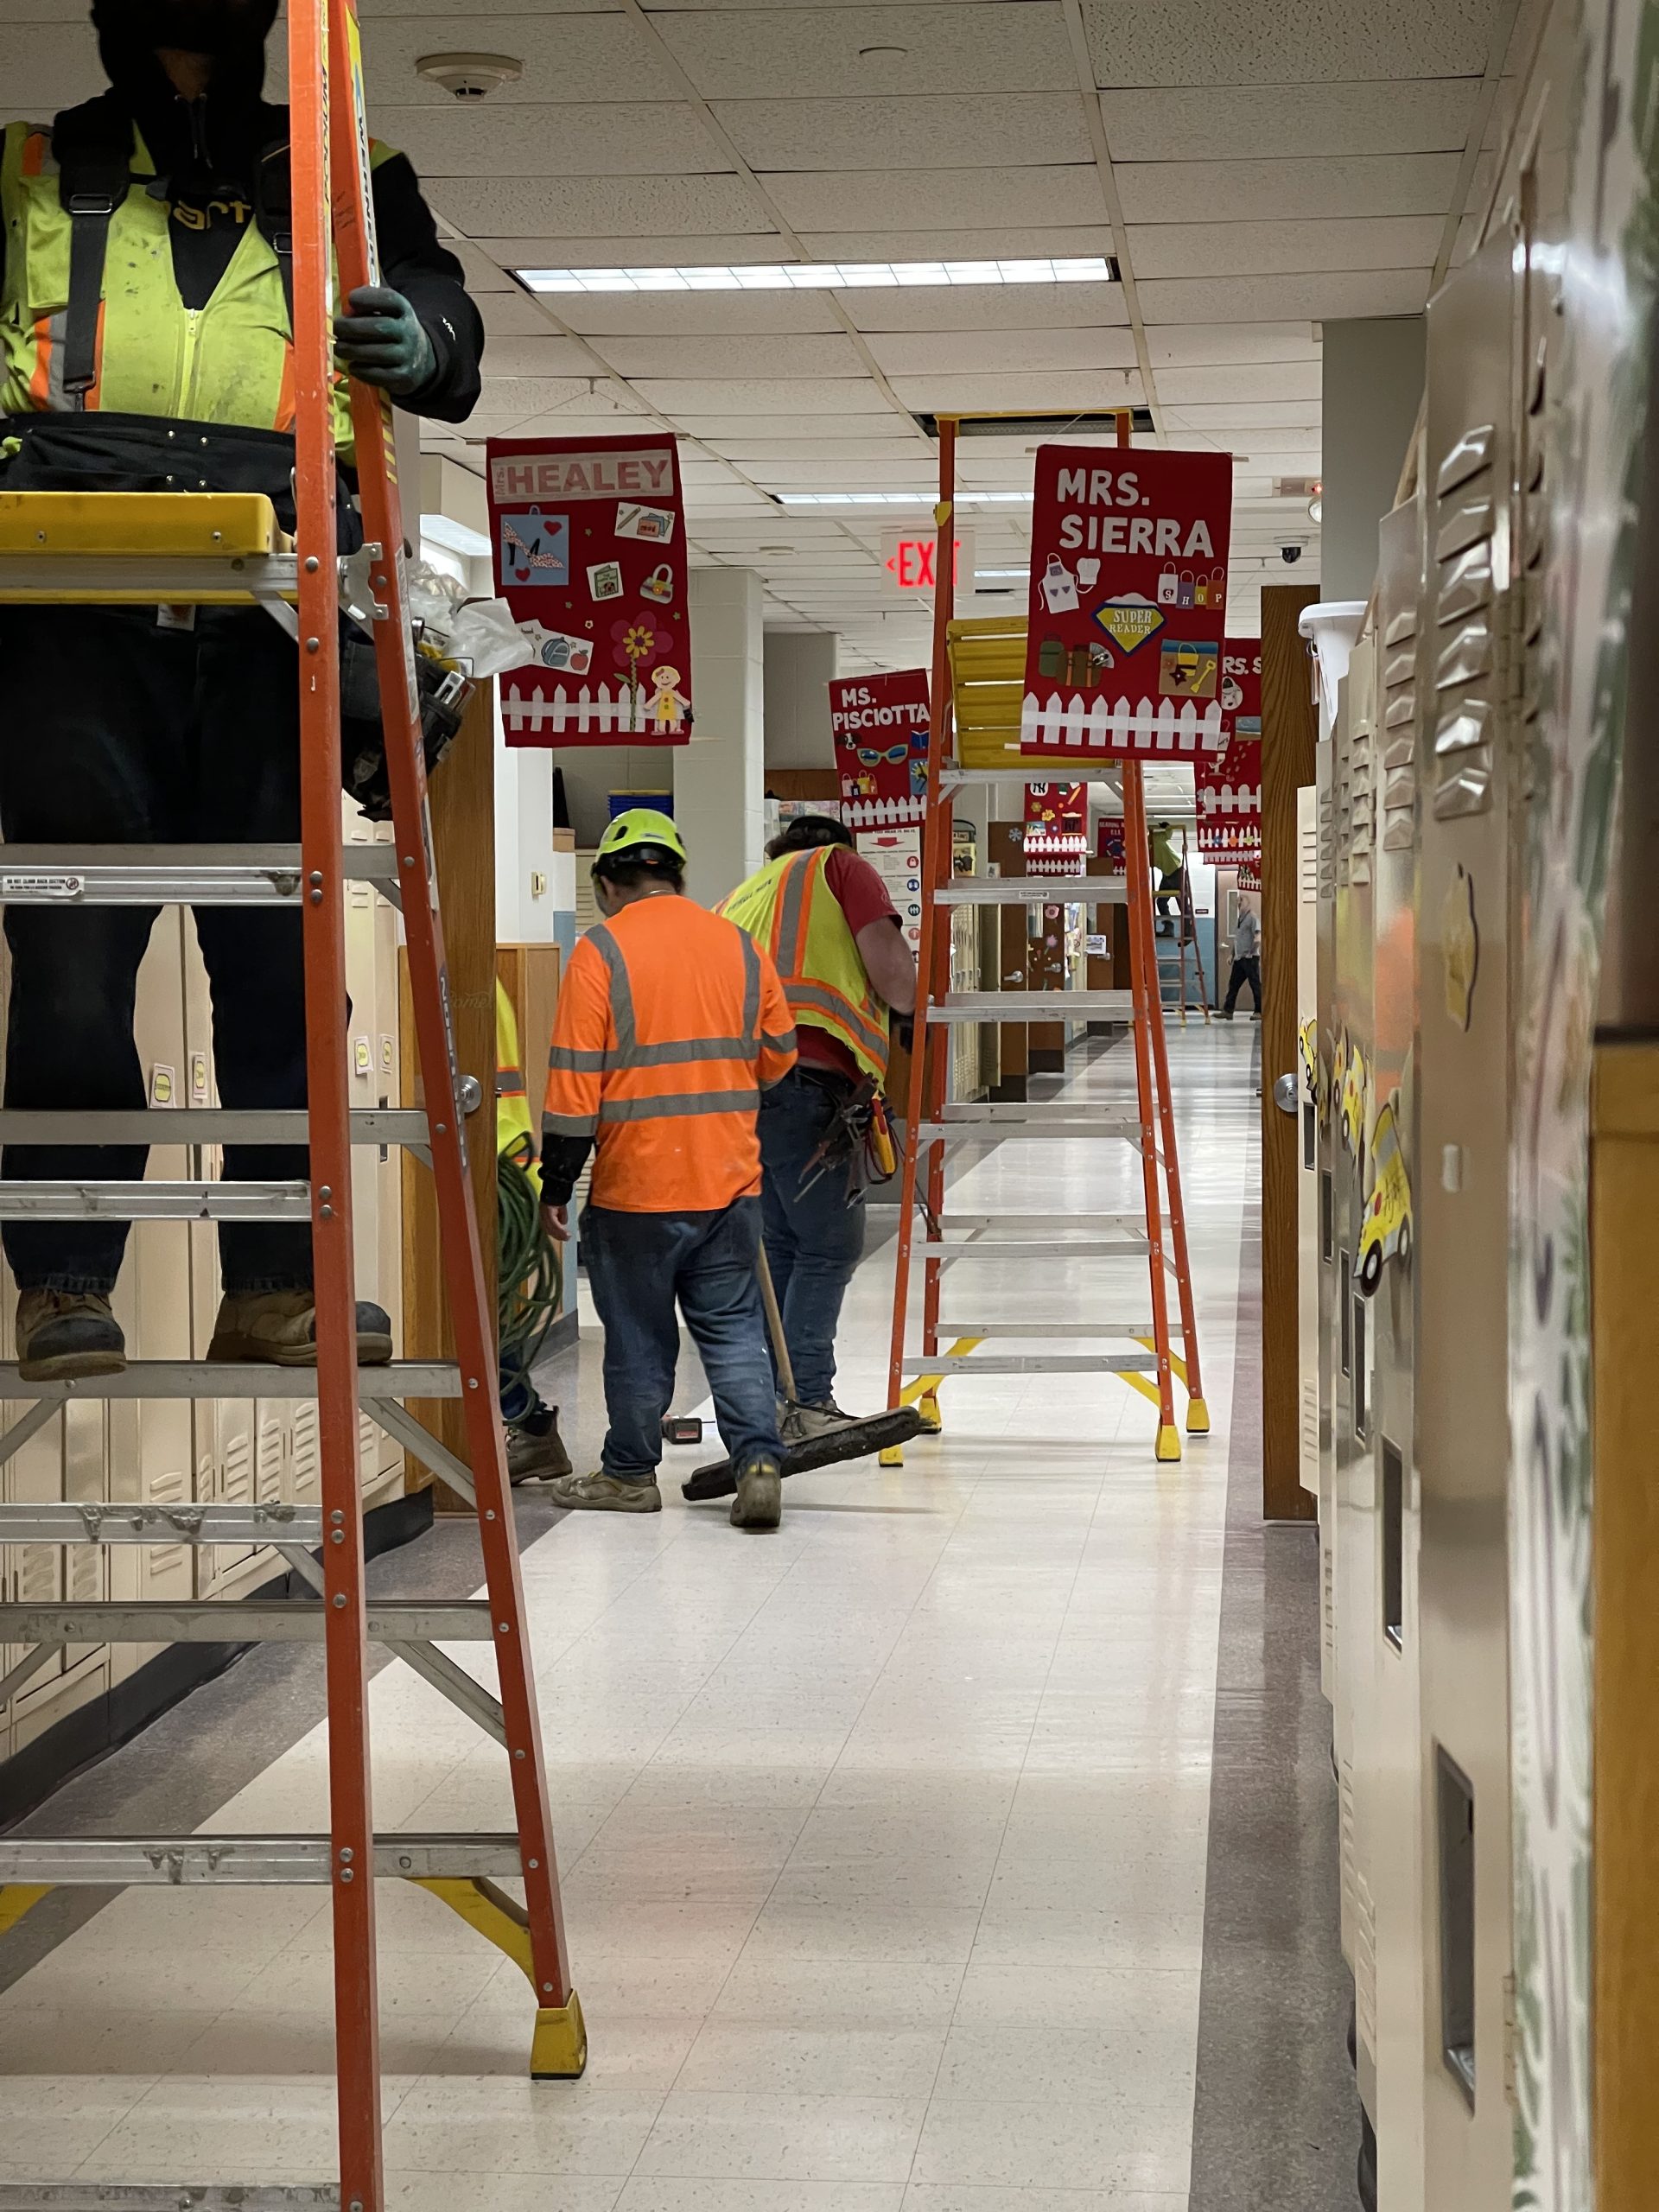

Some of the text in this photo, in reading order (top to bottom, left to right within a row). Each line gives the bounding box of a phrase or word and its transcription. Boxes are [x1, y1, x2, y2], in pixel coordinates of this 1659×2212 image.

[359, 117, 374, 265] WERNER
[507, 460, 668, 494] HEALEY
[1057, 468, 1150, 506] MRS.
[1059, 514, 1214, 558] SIERRA
[899, 542, 961, 586] EXT
[1109, 624, 1151, 633] READER
[1114, 610, 1152, 623] SUPER
[1223, 656, 1249, 675] RS.
[842, 688, 876, 708] MS.
[832, 703, 931, 731] PISCIOTTA
